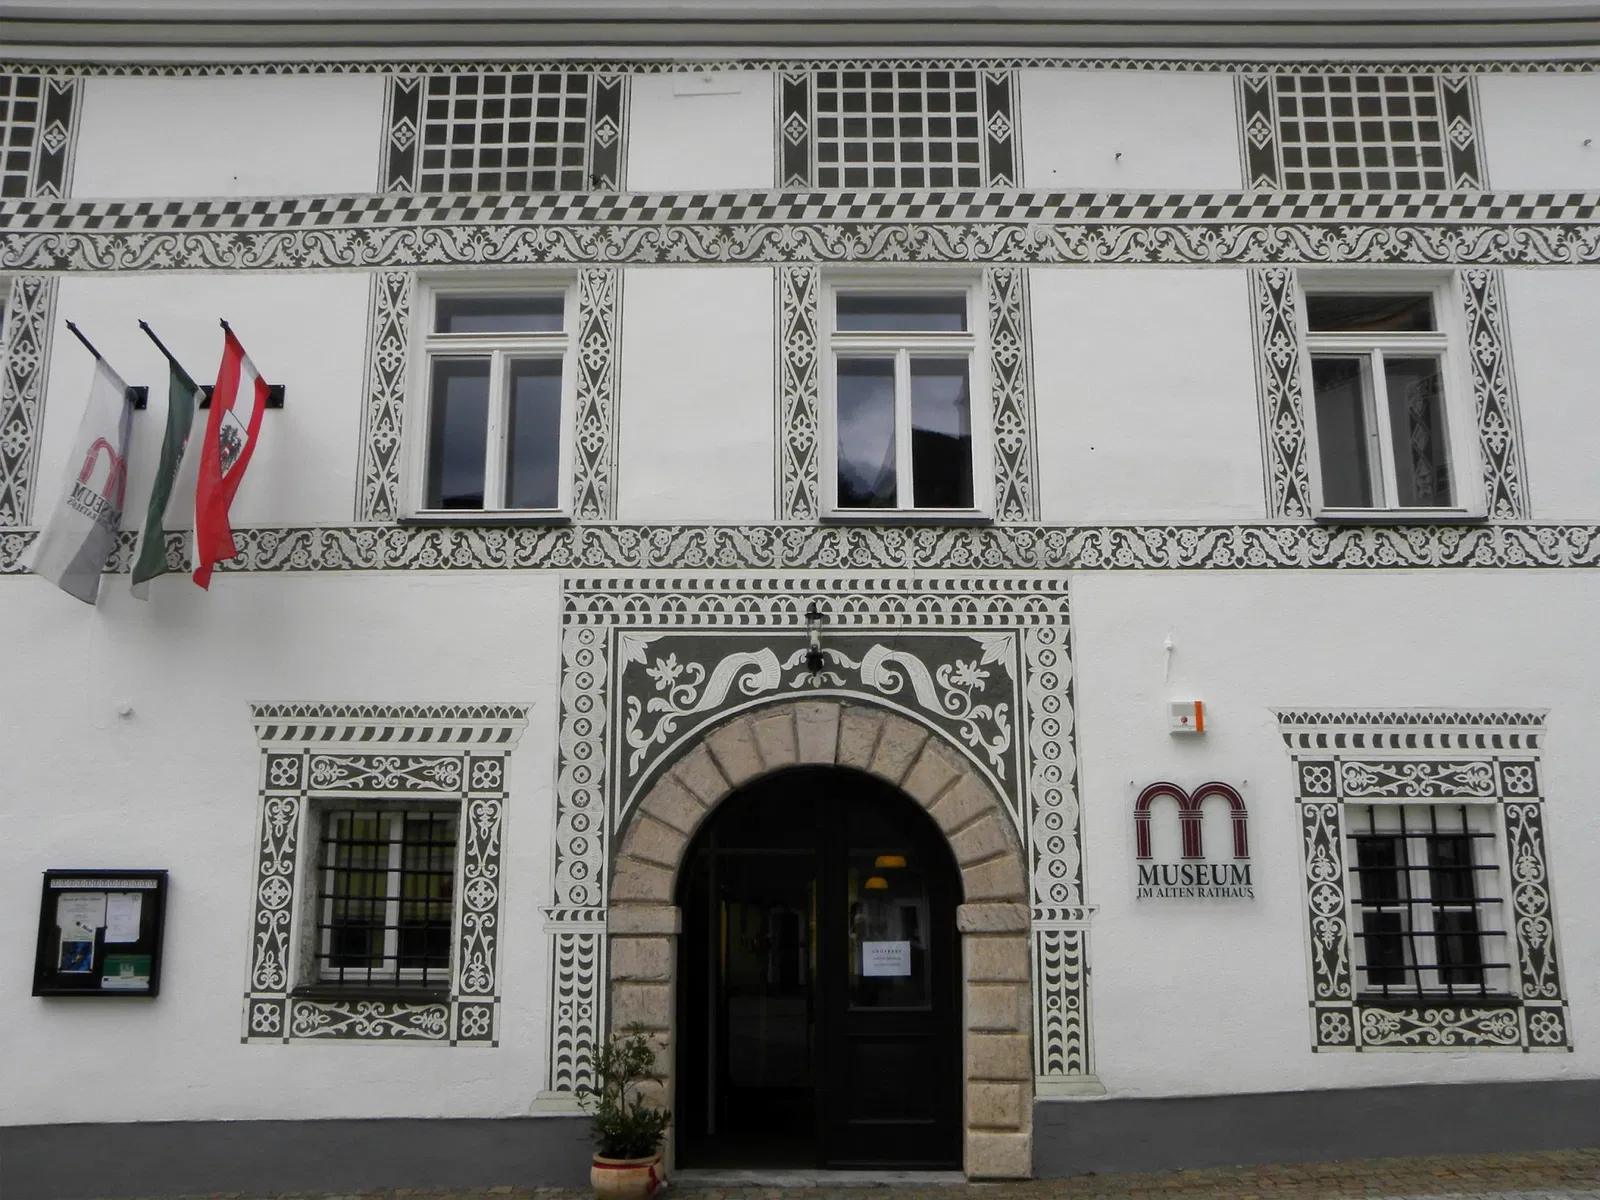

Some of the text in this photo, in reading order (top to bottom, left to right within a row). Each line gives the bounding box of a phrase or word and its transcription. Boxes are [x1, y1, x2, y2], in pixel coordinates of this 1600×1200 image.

[1137, 863, 1253, 886] MUSEUM
[1138, 887, 1254, 898] IM ALTEN RATHAUS
